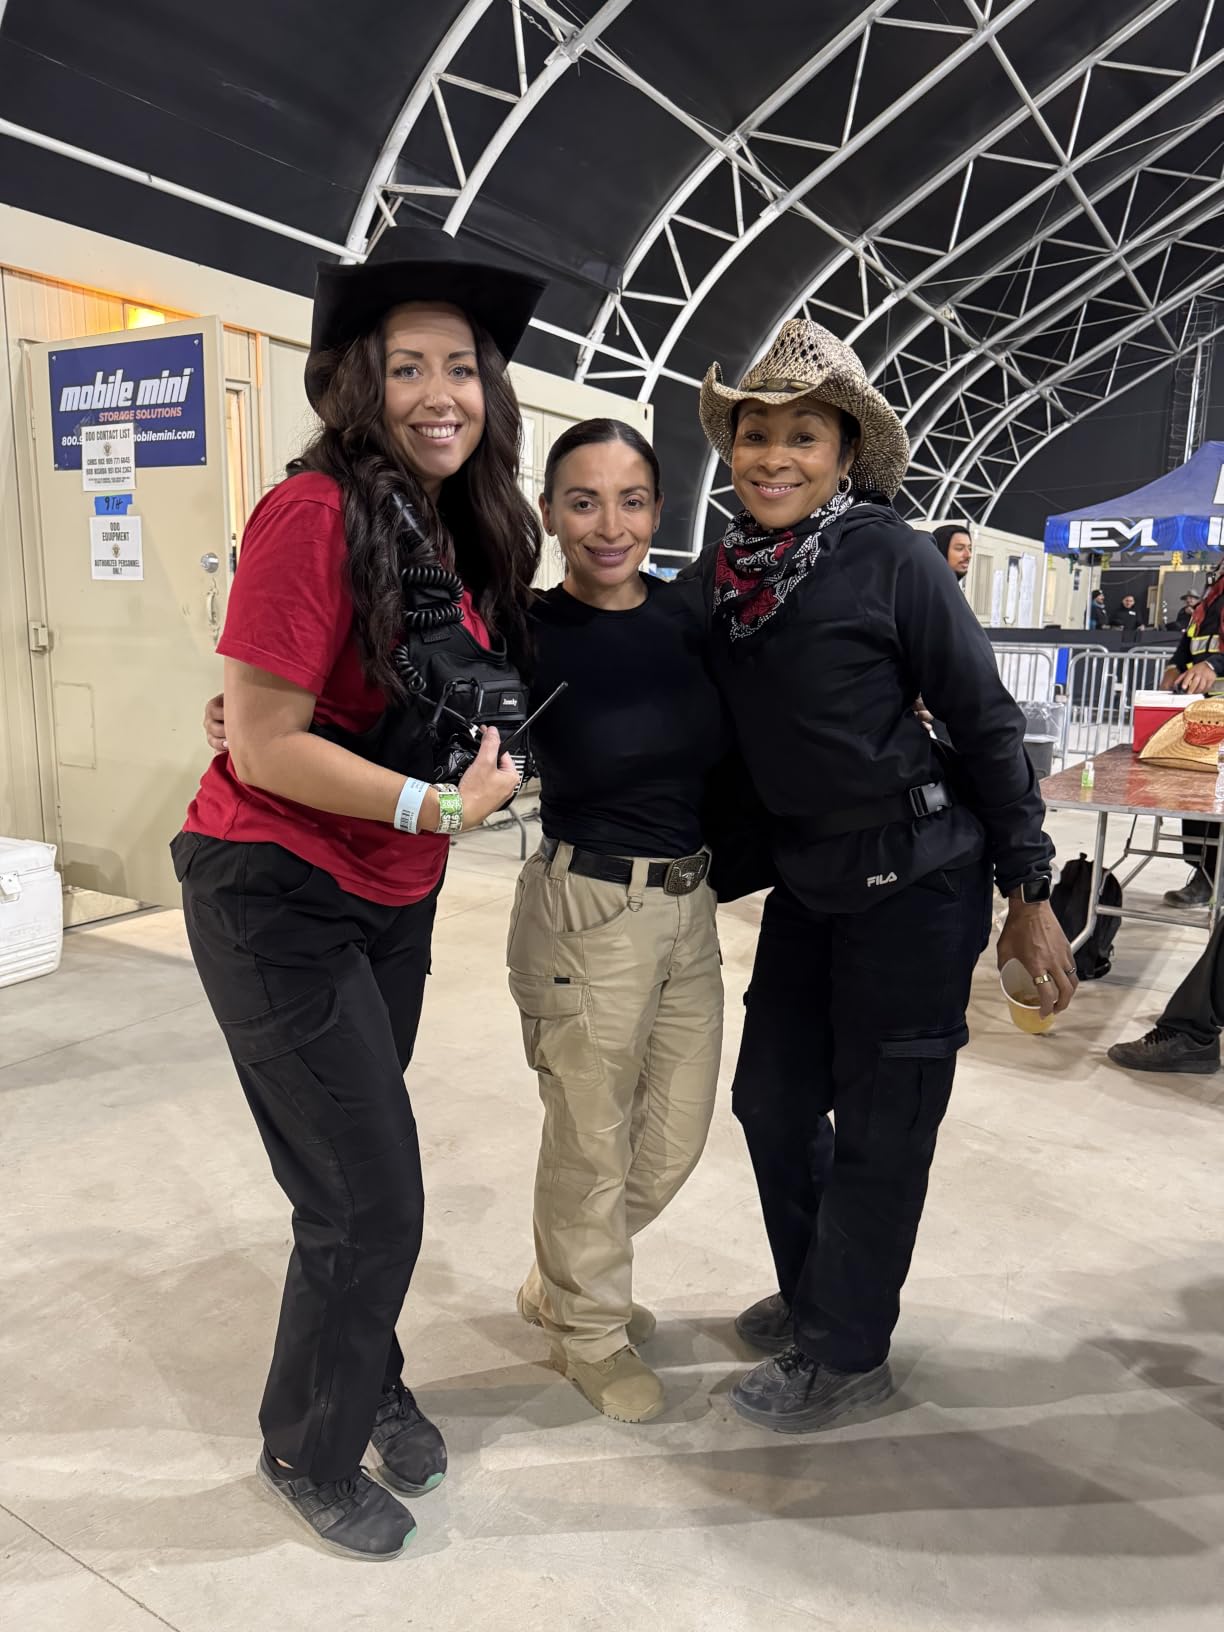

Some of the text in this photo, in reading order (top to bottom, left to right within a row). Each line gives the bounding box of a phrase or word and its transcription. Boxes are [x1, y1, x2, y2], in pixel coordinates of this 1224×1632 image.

[59, 367, 191, 412] mobile mini
[98, 406, 182, 422] STORAGE SOLUTIONS
[97, 429, 118, 440] CONTACT
[119, 428, 130, 439] LIST
[102, 532, 129, 542] EQUIPMENT
[1068, 518, 1158, 548] IEM
[118, 559, 140, 568] PERSONNEL
[867, 871, 898, 888] FILA
